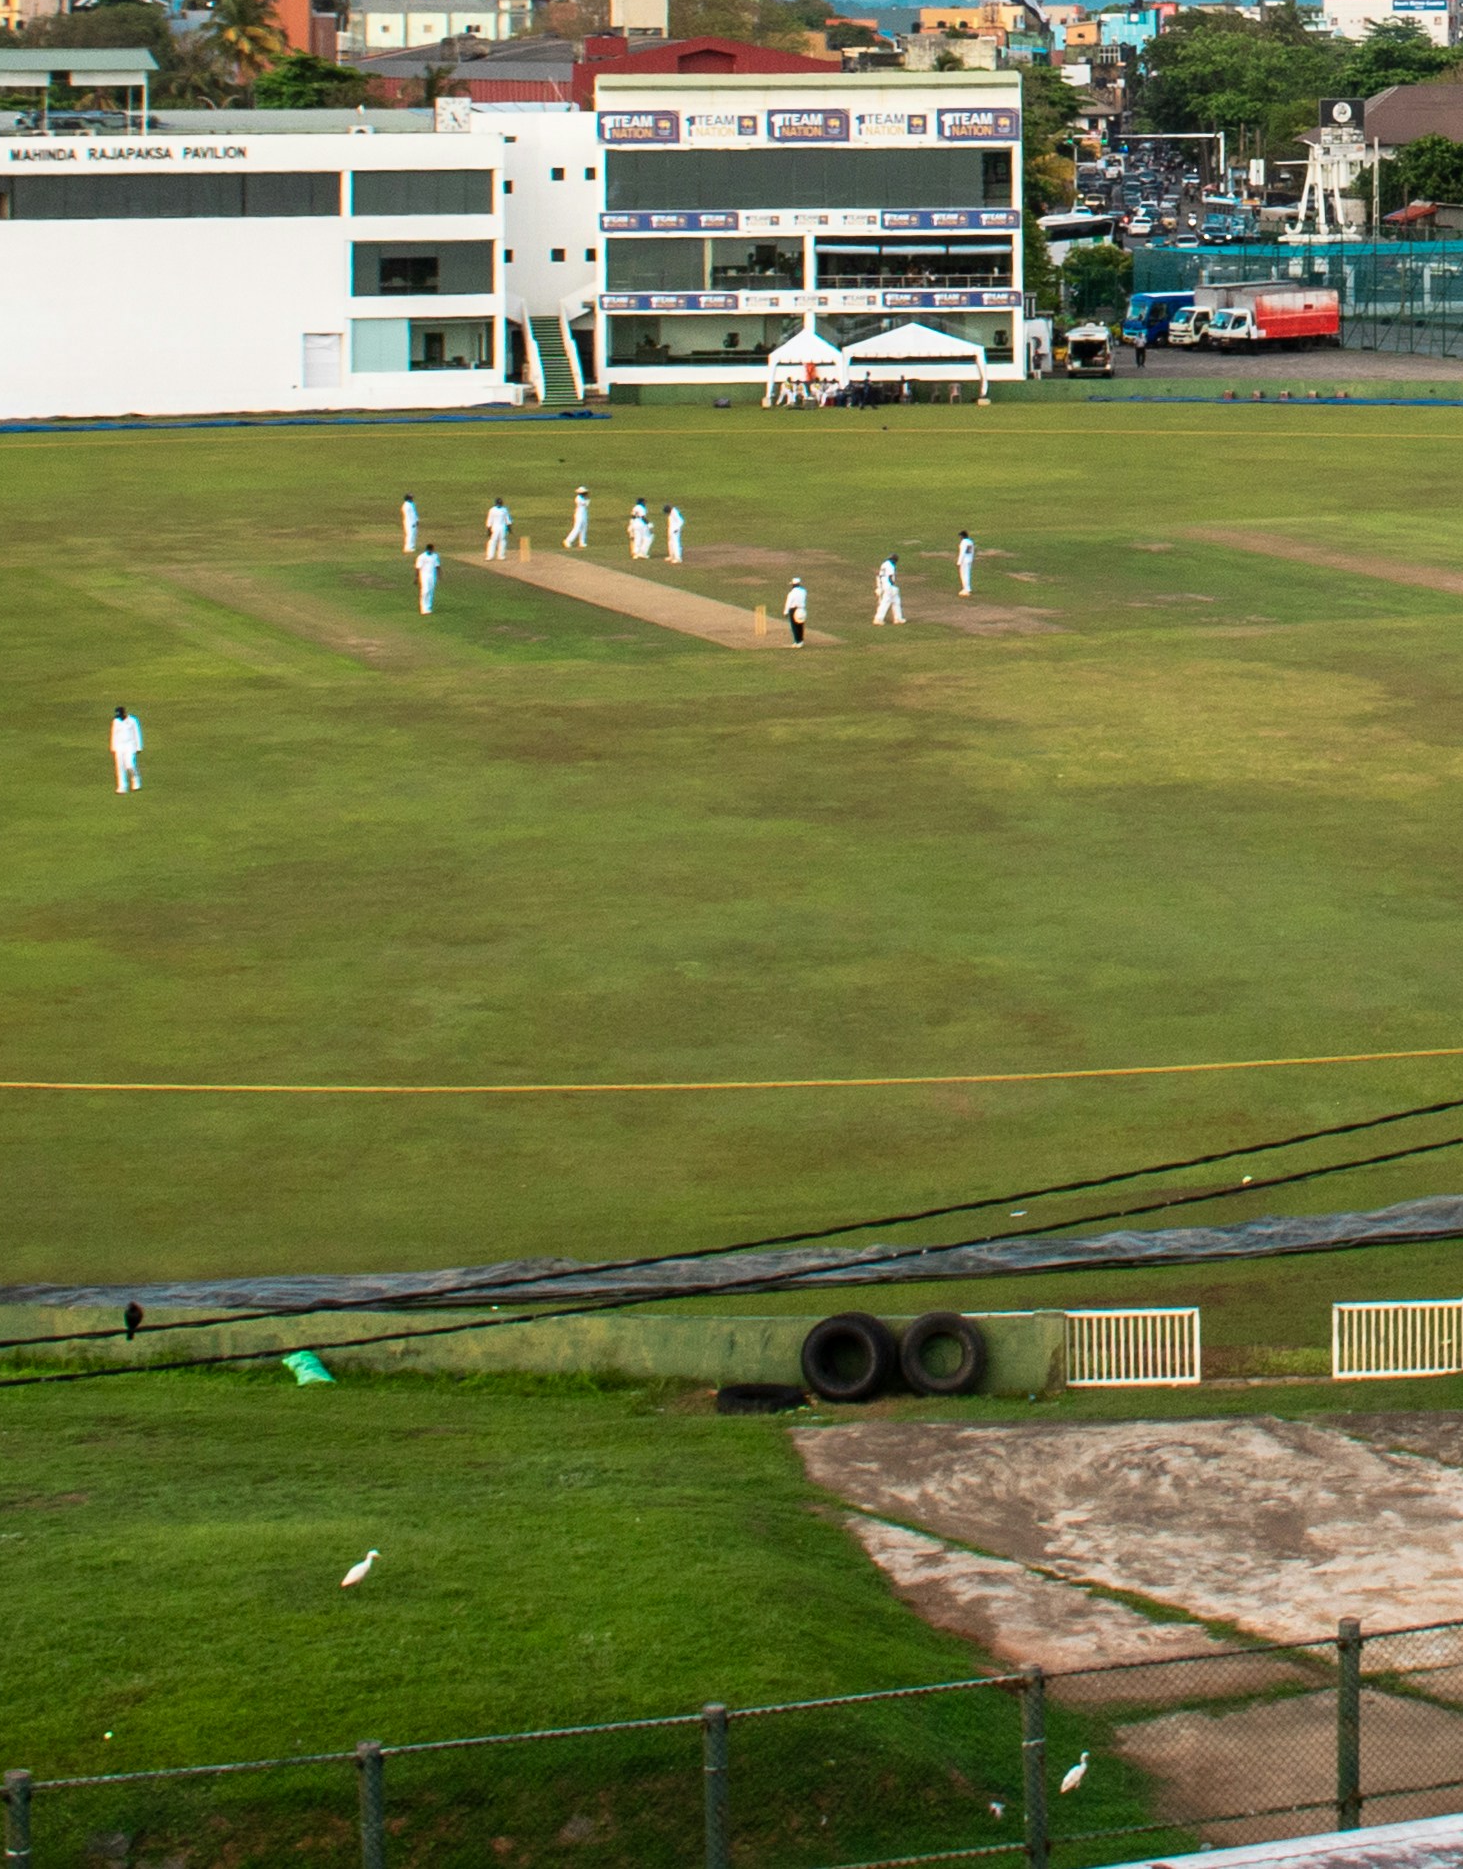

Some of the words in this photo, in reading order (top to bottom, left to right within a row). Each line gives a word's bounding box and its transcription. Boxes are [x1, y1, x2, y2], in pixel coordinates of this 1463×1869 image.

[612, 128, 653, 139] NATION
[782, 126, 823, 137] NATION
[952, 125, 993, 136] NATION
[10, 148, 77, 162] MAHINDA
[88, 147, 173, 161] RAJAPAKSA
[183, 146, 247, 160] PAVILION
